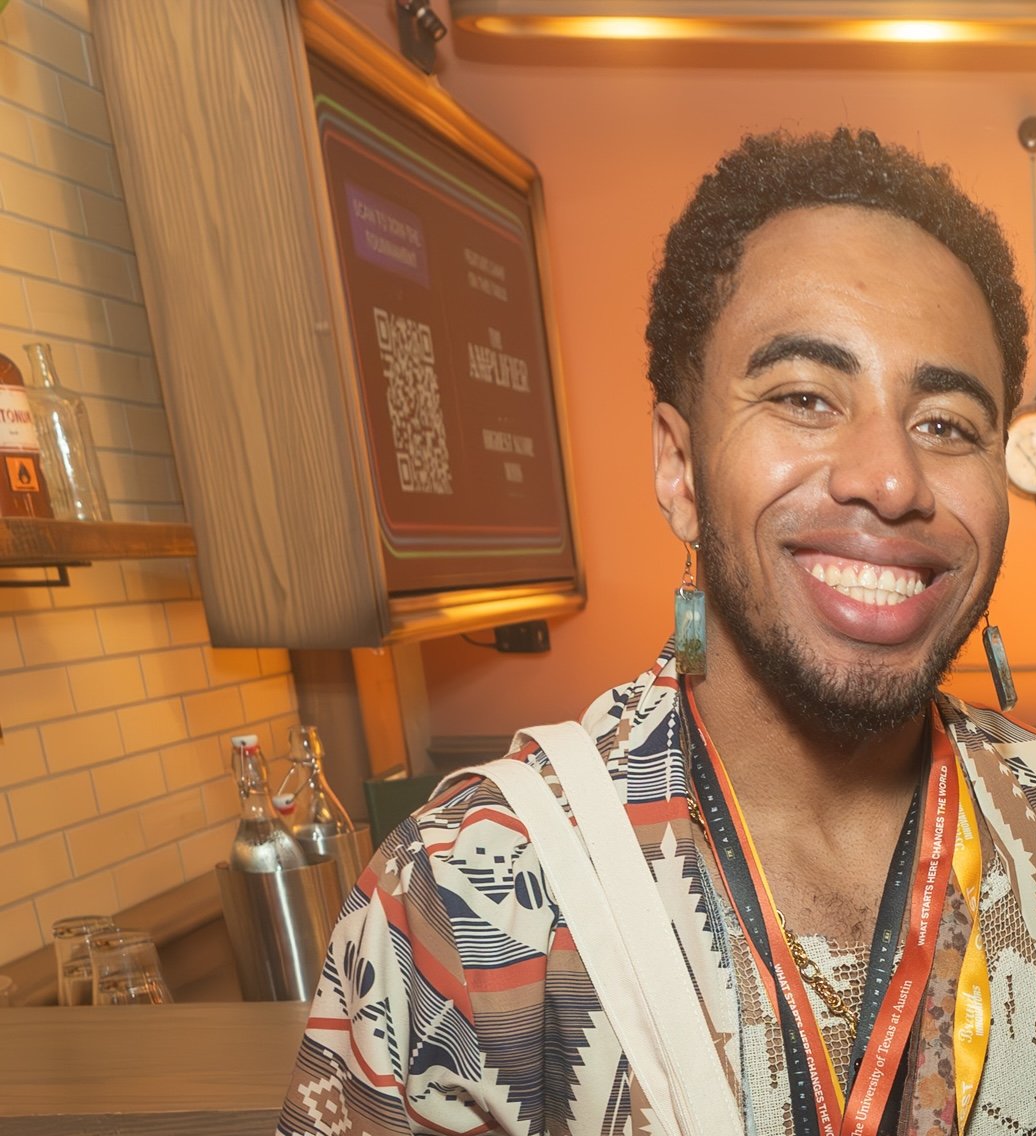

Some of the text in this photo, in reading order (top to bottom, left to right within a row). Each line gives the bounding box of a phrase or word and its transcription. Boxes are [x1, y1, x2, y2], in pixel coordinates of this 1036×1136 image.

[467, 341, 531, 393] AMPLIFIER
[918, 765, 949, 946] WHAT STARTS HERE CHANGES THE WORLD
[893, 979, 913, 1014] Austin
[877, 1025, 898, 1055] Texas
[891, 1012, 901, 1025] at
[774, 963, 792, 991] WHAT
[806, 1056, 825, 1103] CHANGES
[818, 1103, 828, 1125] THE
[876, 1053, 887, 1068] of
[856, 1069, 886, 1120] University
